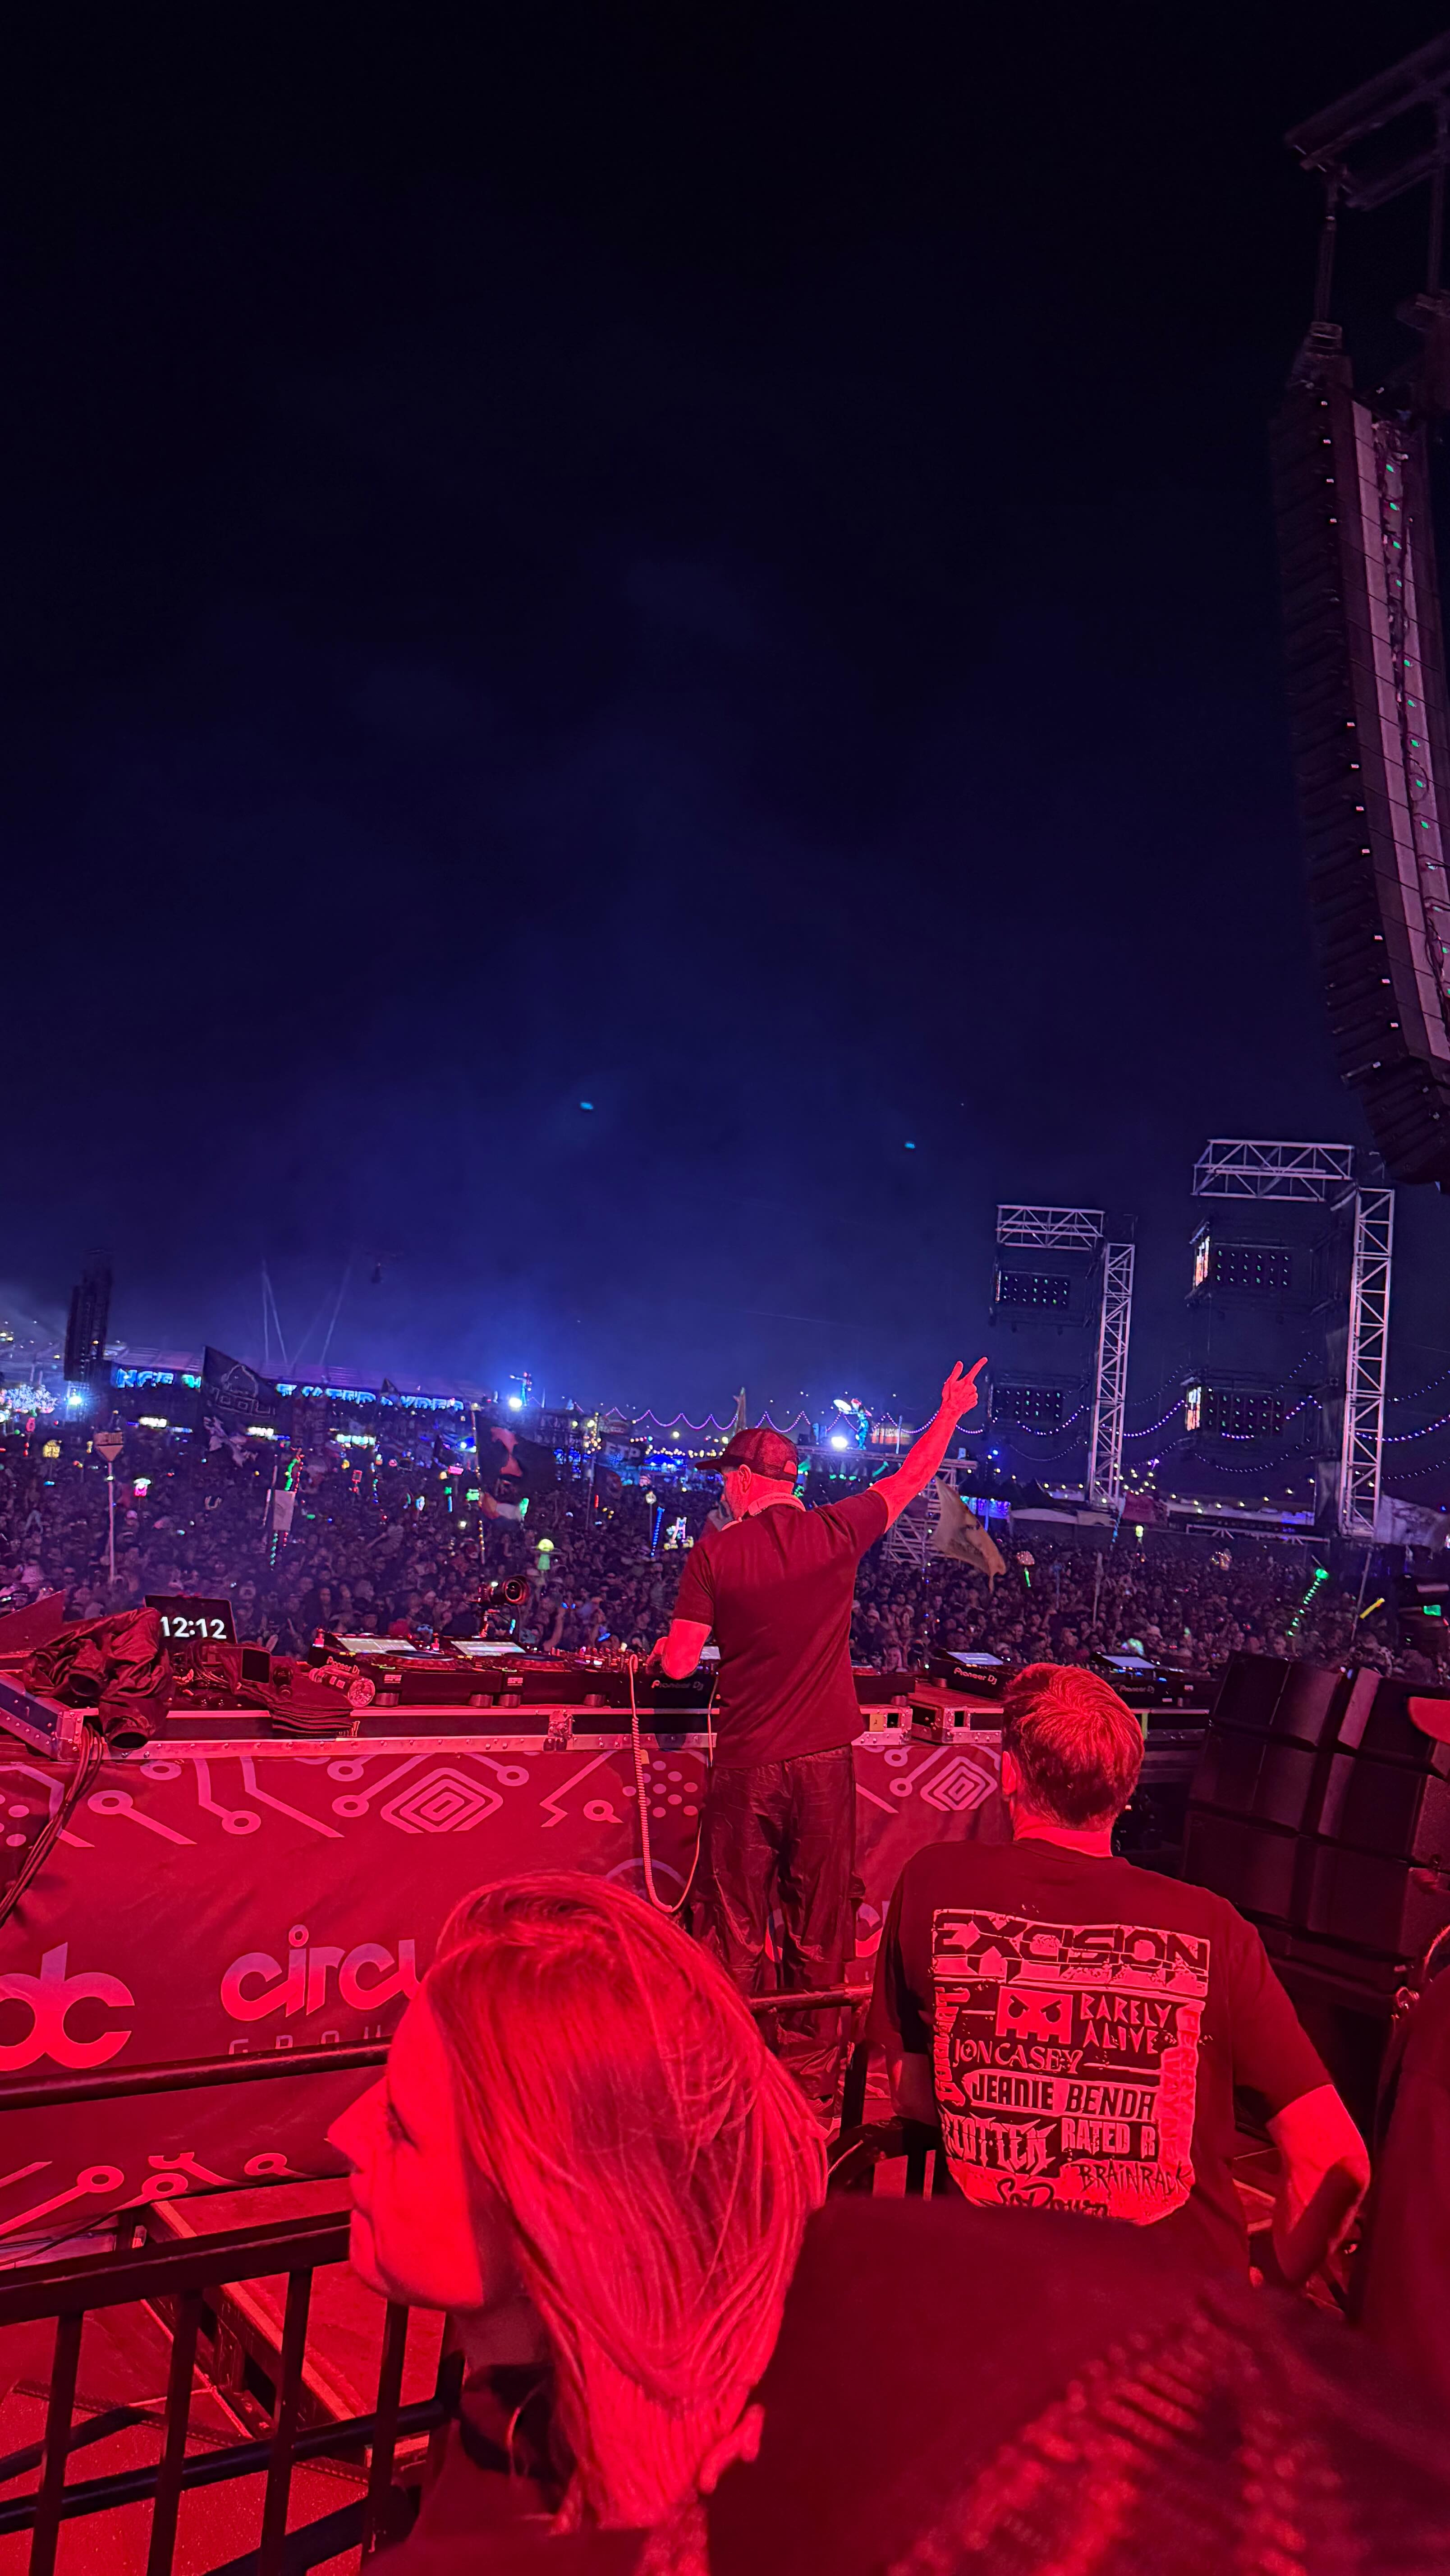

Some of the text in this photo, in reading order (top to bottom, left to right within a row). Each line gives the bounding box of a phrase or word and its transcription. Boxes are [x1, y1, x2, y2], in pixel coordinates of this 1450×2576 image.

[160, 1616, 227, 1640] 12:12
[651, 1679, 691, 1688] Pioneer
[954, 1667, 998, 1685] Pioneer DJ
[935, 1914, 1207, 1983] EXCISION
[1079, 1992, 1173, 2029] BARELY
[1083, 2020, 1160, 2055] ALIVE
[1061, 2117, 1156, 2159] RATED R
